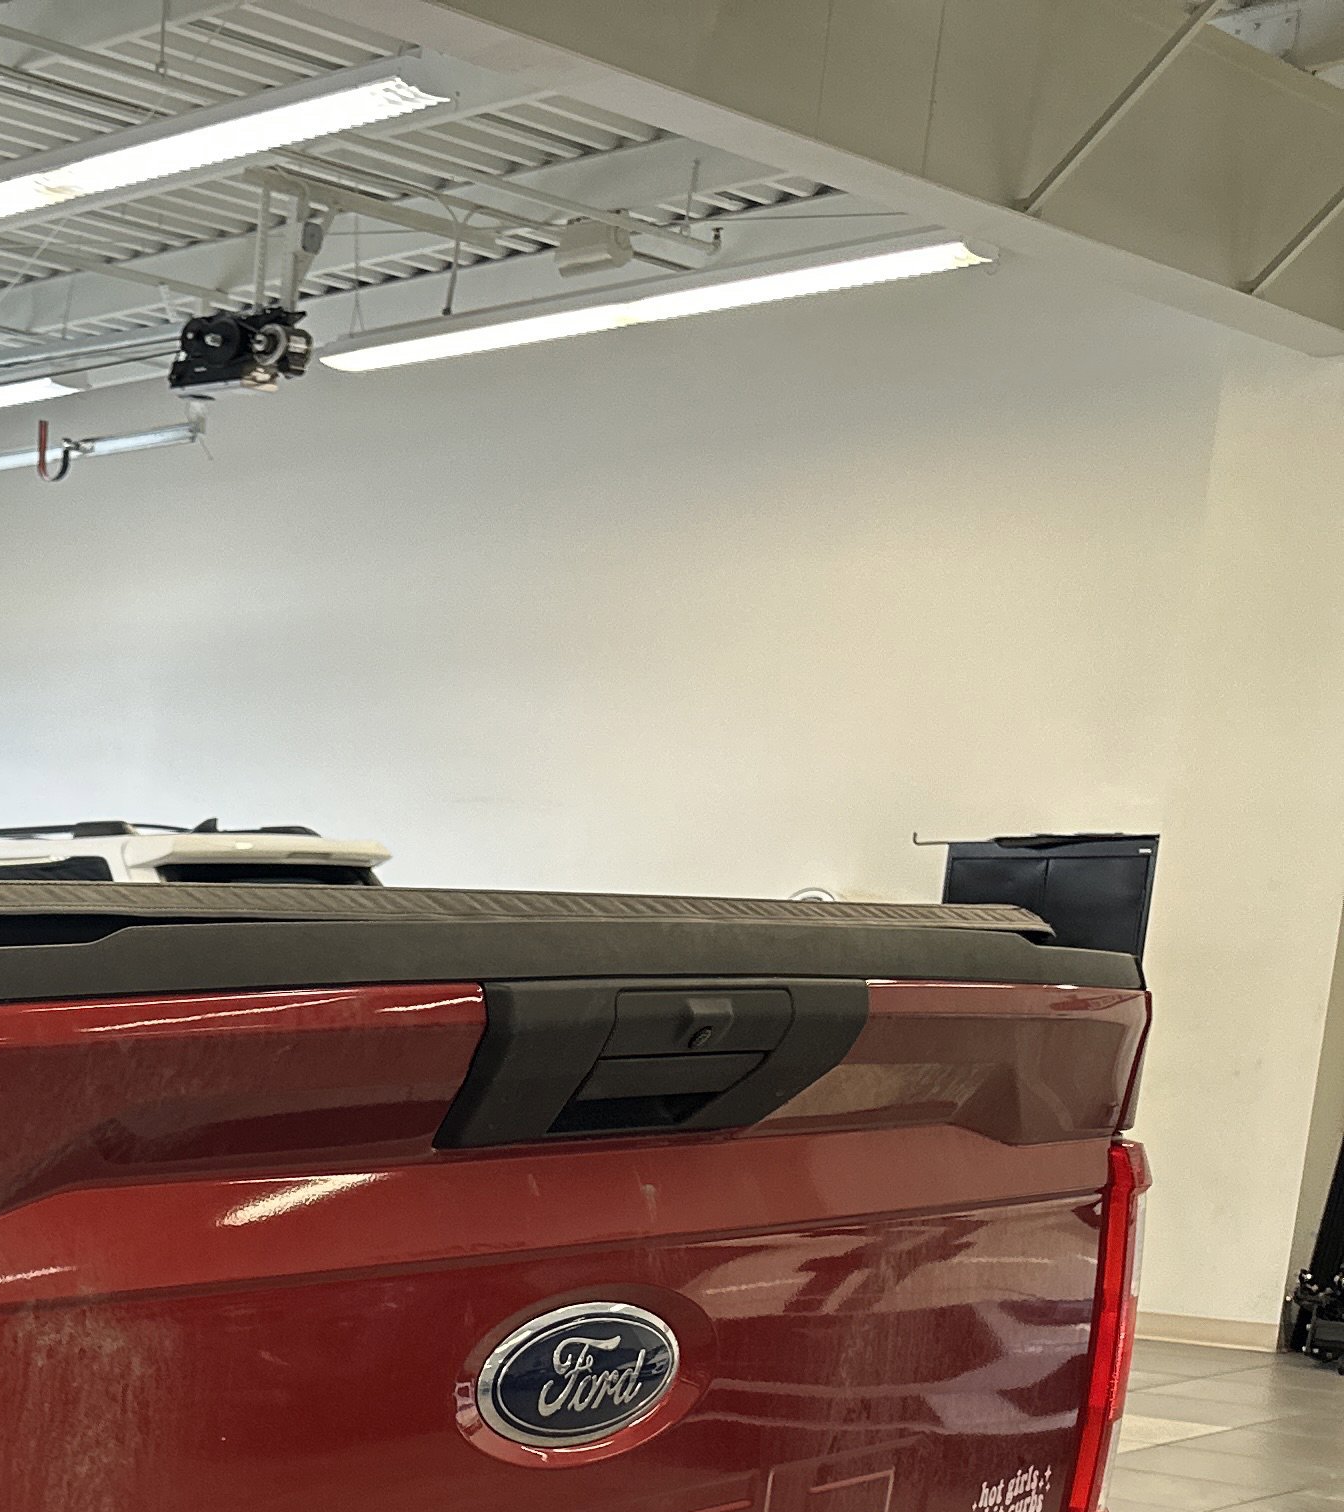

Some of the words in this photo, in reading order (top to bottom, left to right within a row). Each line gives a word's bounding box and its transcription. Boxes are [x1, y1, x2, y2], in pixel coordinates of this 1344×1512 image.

[537, 1335, 646, 1417] Ford
[978, 1479, 1005, 1508] hot
[1005, 1465, 1039, 1506] girls
